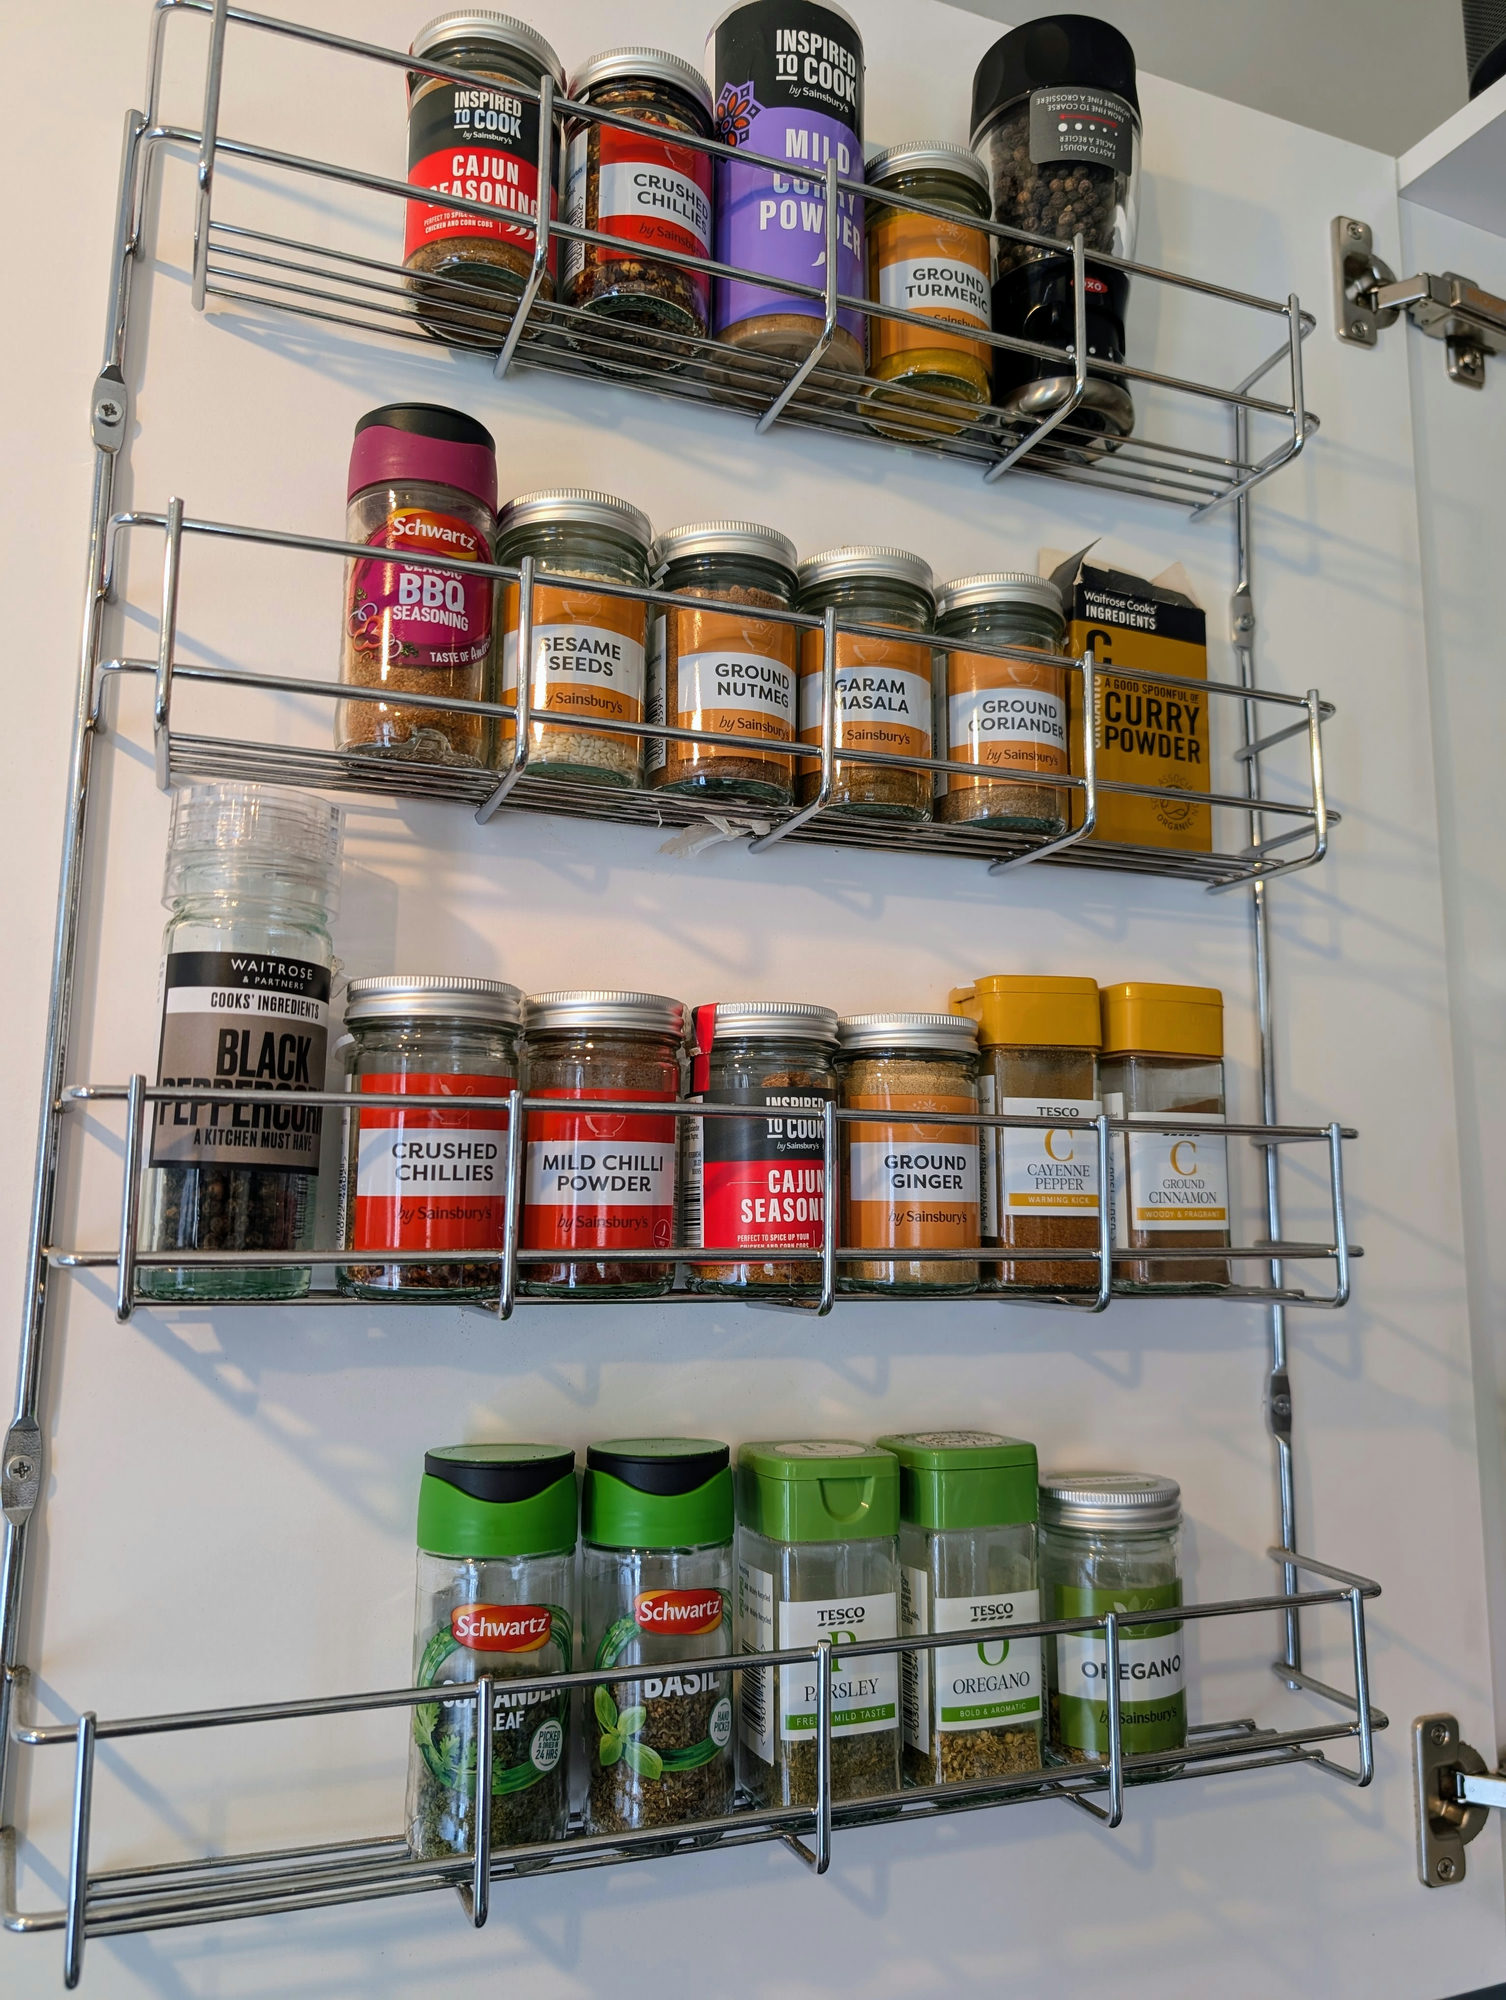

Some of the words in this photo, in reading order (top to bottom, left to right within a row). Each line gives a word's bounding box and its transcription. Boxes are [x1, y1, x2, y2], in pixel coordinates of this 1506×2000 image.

[776, 30, 856, 78] INSPIRED
[776, 54, 798, 74] TO
[804, 57, 855, 108] COOK
[454, 91, 521, 117] INSPIRED
[789, 85, 801, 97] by
[802, 87, 849, 113] Sainsbury's
[1047, 103, 1079, 112] COARSE
[1080, 103, 1090, 111] TO
[454, 108, 470, 124] TO
[474, 109, 521, 139] COOK
[463, 131, 472, 139] by
[473, 131, 512, 144] Sainsbury's
[785, 128, 850, 175] MILD
[452, 155, 518, 186] CAJUN
[429, 180, 538, 215] EASONING
[634, 174, 708, 220] CRUSHED
[773, 172, 855, 216] CUY
[424, 213, 443, 226] PERFECT
[444, 212, 450, 220] TO
[637, 192, 706, 236] CHILLIES
[639, 222, 655, 239] by
[656, 227, 702, 257] Sainsbu
[760, 199, 860, 262] POWER
[913, 268, 984, 294] GROUND
[905, 284, 988, 314] TURMERIC
[392, 517, 475, 550] Schwartz
[399, 573, 465, 614] BBQ
[1084, 590, 1126, 609] Waitrose
[1126, 599, 1157, 615] Cooks'
[393, 606, 469, 631] SEASONING
[1086, 604, 1157, 630] INGREDIENTS
[430, 652, 459, 663] TASTE
[460, 652, 469, 662] OF
[544, 637, 621, 661] SESAME
[549, 656, 613, 677] SEEDS
[715, 663, 790, 690] GROUND
[717, 682, 789, 708] NUTMEG
[835, 678, 905, 695] GARAM
[1105, 678, 1110, 688] A
[1114, 680, 1139, 693] GOOD
[1142, 684, 1188, 702] SPOONFUL
[555, 692, 623, 714] Sainsbury's
[983, 700, 1057, 719] GROUND
[1105, 692, 1200, 736] CURRY
[719, 716, 736, 732] by
[737, 718, 790, 741] Sainsbury's
[846, 729, 911, 745] Sainsbury's
[968, 717, 1064, 740] CORIANDER
[1105, 725, 1201, 764] POWDER
[986, 749, 1003, 764] by
[1004, 749, 1059, 766] Sainsbury's
[231, 958, 313, 981] WAITROSE
[243, 975, 249, 983] &
[254, 976, 304, 990] PARTNERS
[211, 992, 255, 1010] COOKS'
[257, 995, 320, 1020] INGREDIENTS
[216, 1028, 312, 1084] BLACK
[1037, 1107, 1079, 1117] TESCO
[767, 1118, 783, 1133] TO
[786, 1118, 824, 1139] COOK
[194, 1128, 201, 1145] A
[204, 1129, 257, 1147] KITCHEN
[261, 1131, 291, 1149] MUST
[293, 1135, 312, 1152] HAVE
[392, 1142, 498, 1160] CRUSHED
[777, 1141, 786, 1151] by
[786, 1141, 820, 1150] Sainsbury's
[1044, 1129, 1074, 1162] C
[543, 1154, 596, 1170] MILD
[602, 1154, 663, 1172] CHILLI
[884, 1155, 966, 1171] GROUND
[1170, 1141, 1198, 1176] C
[395, 1164, 494, 1182] CHILLIES
[1027, 1164, 1090, 1177] CAYENNE
[557, 1175, 652, 1192] POWDER
[891, 1174, 963, 1190] GINGER
[1035, 1178, 1084, 1191] PEPPER
[1163, 1179, 1205, 1189] GROUND
[1028, 1196, 1068, 1204] WARMING
[1148, 1191, 1217, 1204] CINNAMON
[396, 1205, 416, 1225] by
[417, 1205, 492, 1223] Sainsbury's
[741, 1197, 824, 1223] SEASONI
[888, 1210, 904, 1226] by
[906, 1211, 967, 1225] Sainsbury's
[557, 1214, 573, 1232] by
[575, 1215, 649, 1231] Sainsbury's
[737, 1234, 760, 1242] PERFECT
[762, 1234, 769, 1242] TO
[788, 1233, 796, 1241] UP
[796, 1232, 810, 1240] YOUR
[639, 1600, 719, 1623] Schwartz
[817, 1606, 865, 1621] TESCO
[970, 1602, 1014, 1617] TESCO
[456, 1615, 547, 1637] Schwartz
[644, 1672, 720, 1698] BASIL
[805, 1678, 879, 1702] PRSLEY
[953, 1671, 1030, 1695] OREGANO
[493, 1710, 525, 1731] EAF
[796, 1717, 818, 1725] FRE
[834, 1713, 857, 1722] MILD
[860, 1708, 886, 1719] TASTE
[959, 1709, 981, 1718] BOLD
[991, 1703, 1026, 1714] AROMATIC
[1120, 1706, 1177, 1725] Sainsbury's
[539, 1731, 560, 1741] PICKED
[535, 1750, 545, 1760] 24
[546, 1749, 558, 1760] HRS
